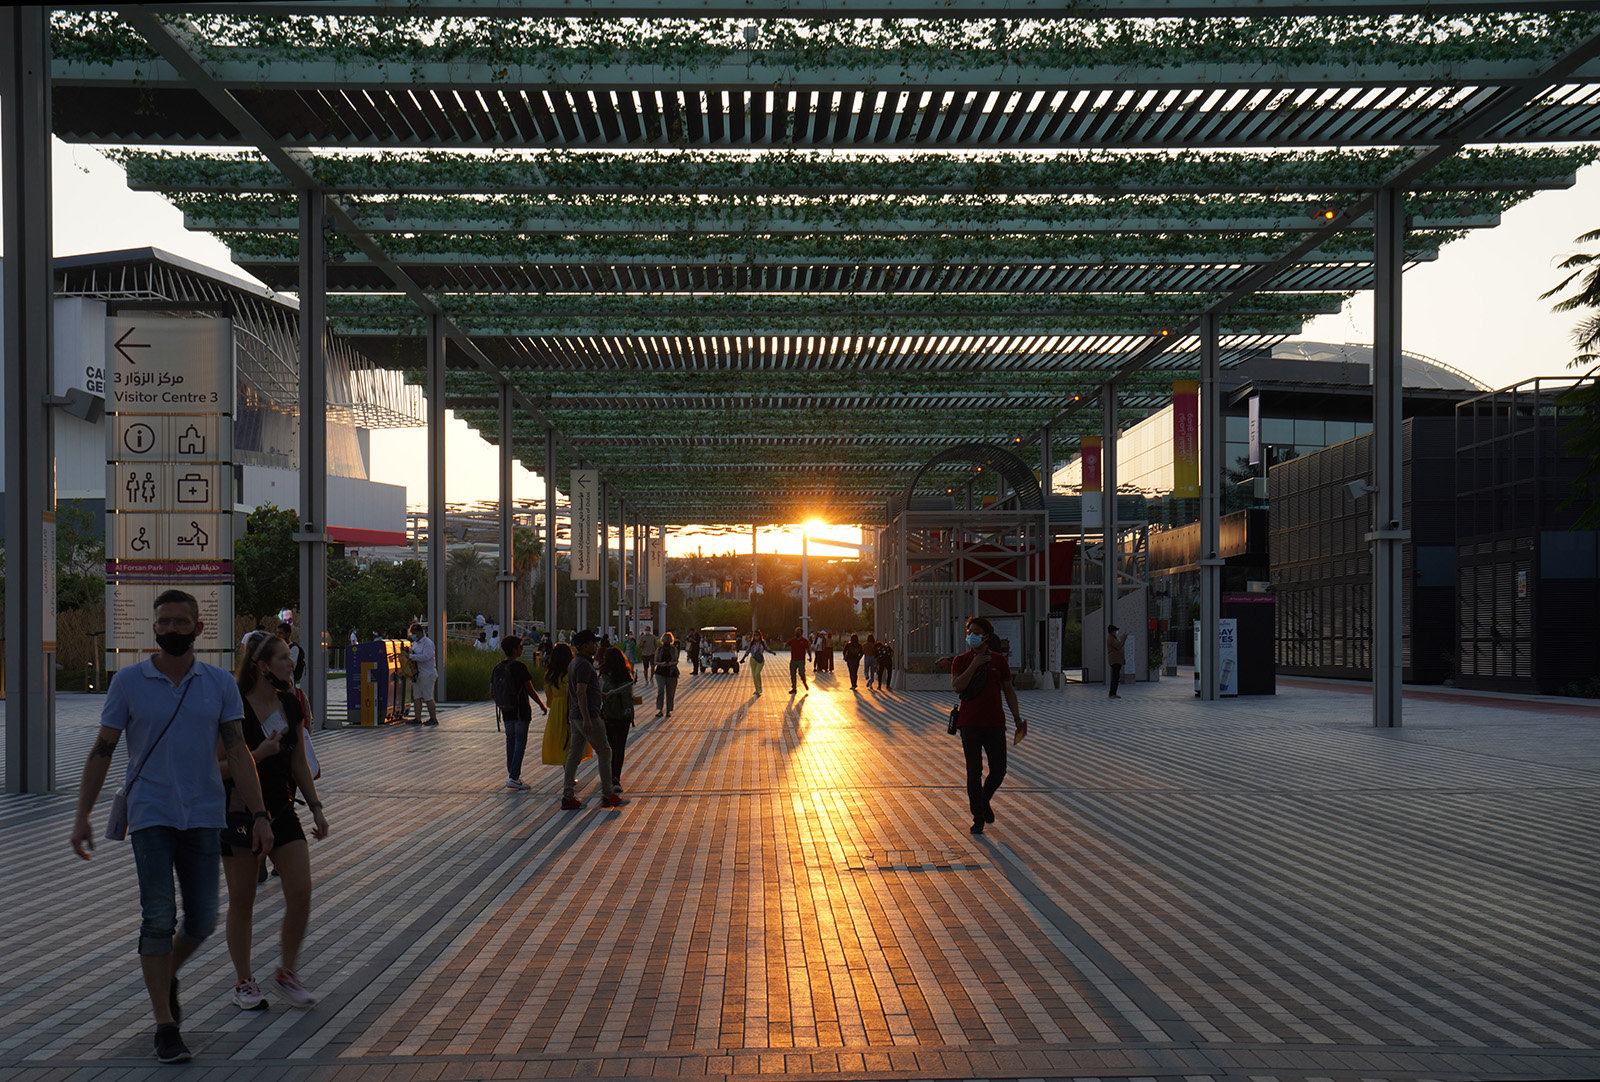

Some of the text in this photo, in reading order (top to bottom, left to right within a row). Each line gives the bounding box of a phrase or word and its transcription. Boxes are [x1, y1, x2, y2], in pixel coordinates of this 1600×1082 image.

[86, 366, 105, 380] CA
[114, 373, 121, 383] 3
[157, 372, 184, 386] مركز
[86, 380, 105, 393] GE
[114, 392, 218, 403] Visitor Centre 3
